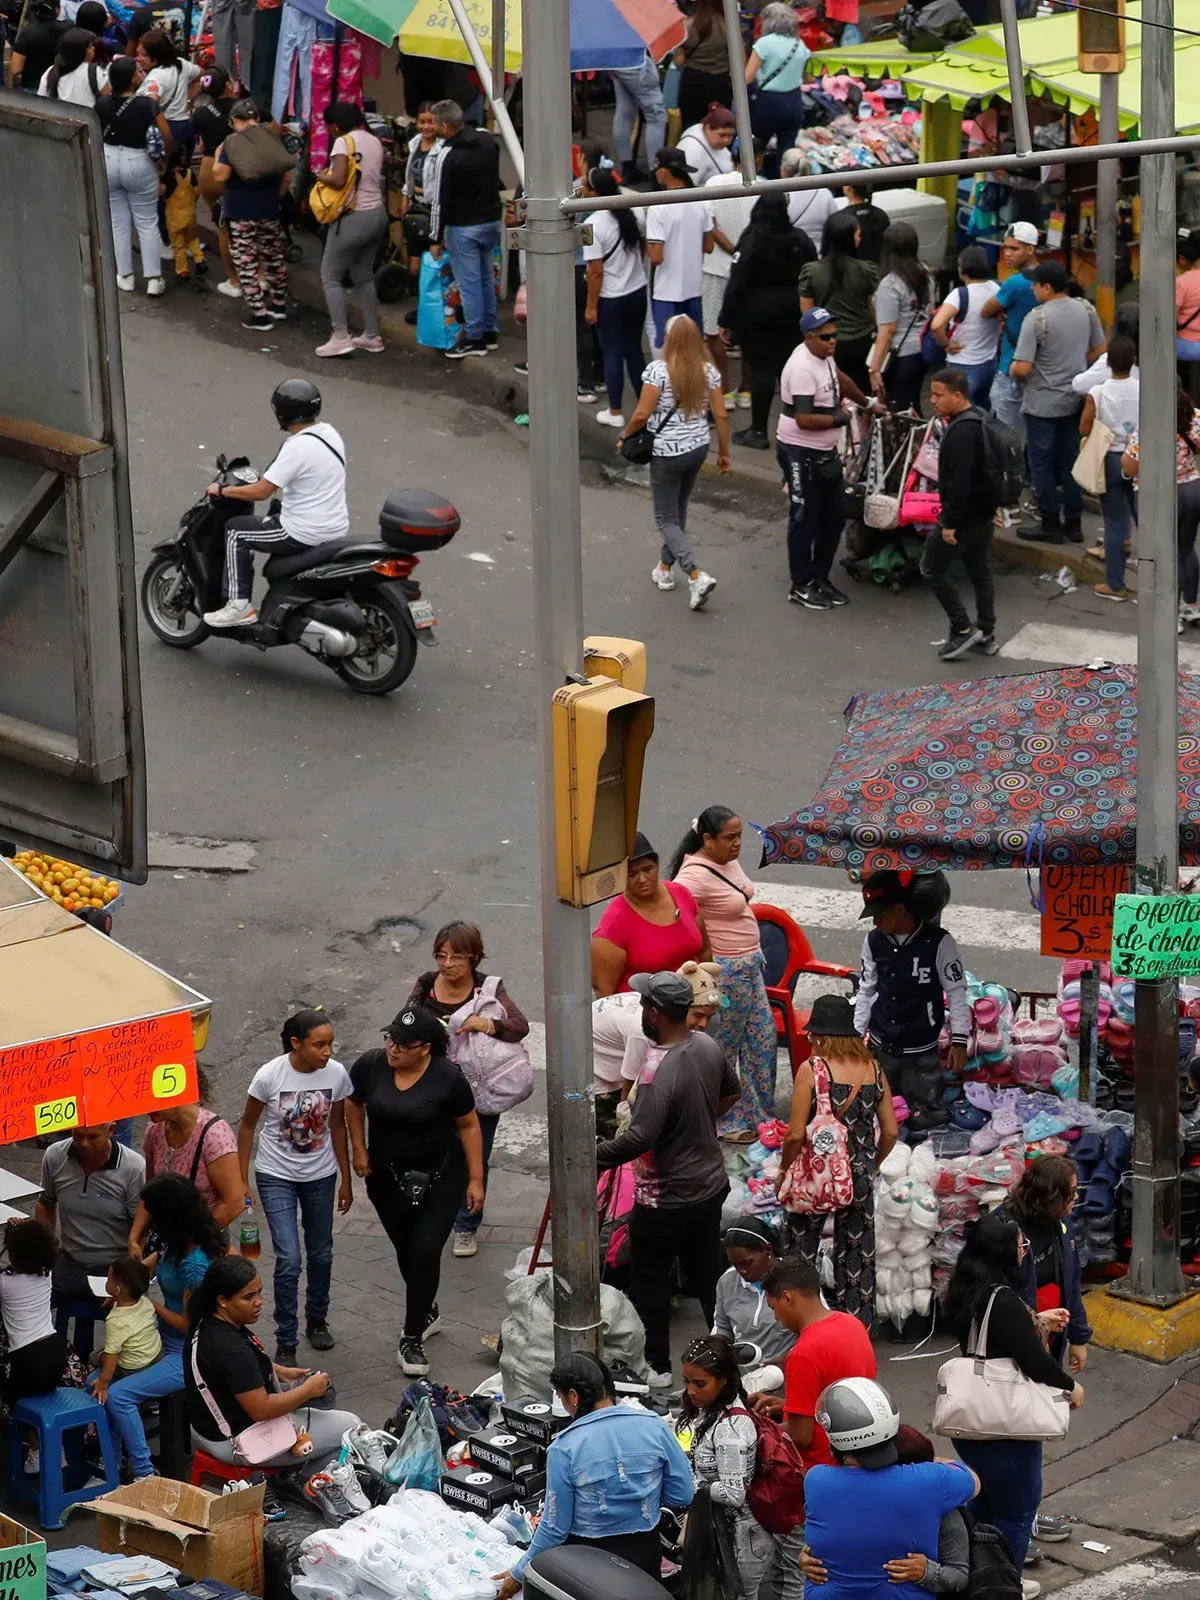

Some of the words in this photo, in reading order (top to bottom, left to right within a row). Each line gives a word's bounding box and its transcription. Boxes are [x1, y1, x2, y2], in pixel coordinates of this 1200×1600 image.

[1053, 893, 1114, 917] CHOLA
[1114, 924, 1147, 952] de
[1115, 952, 1147, 976] 3$
[111, 1019, 159, 1039] OFERTA
[84, 1042, 101, 1077] 2
[161, 1066, 177, 1094] 5
[39, 1101, 76, 1128] 580
[471, 1444, 491, 1461] SWISS
[490, 1453, 512, 1471] SPORT
[443, 1484, 467, 1502] SWISS
[464, 1491, 488, 1510] SPORT
